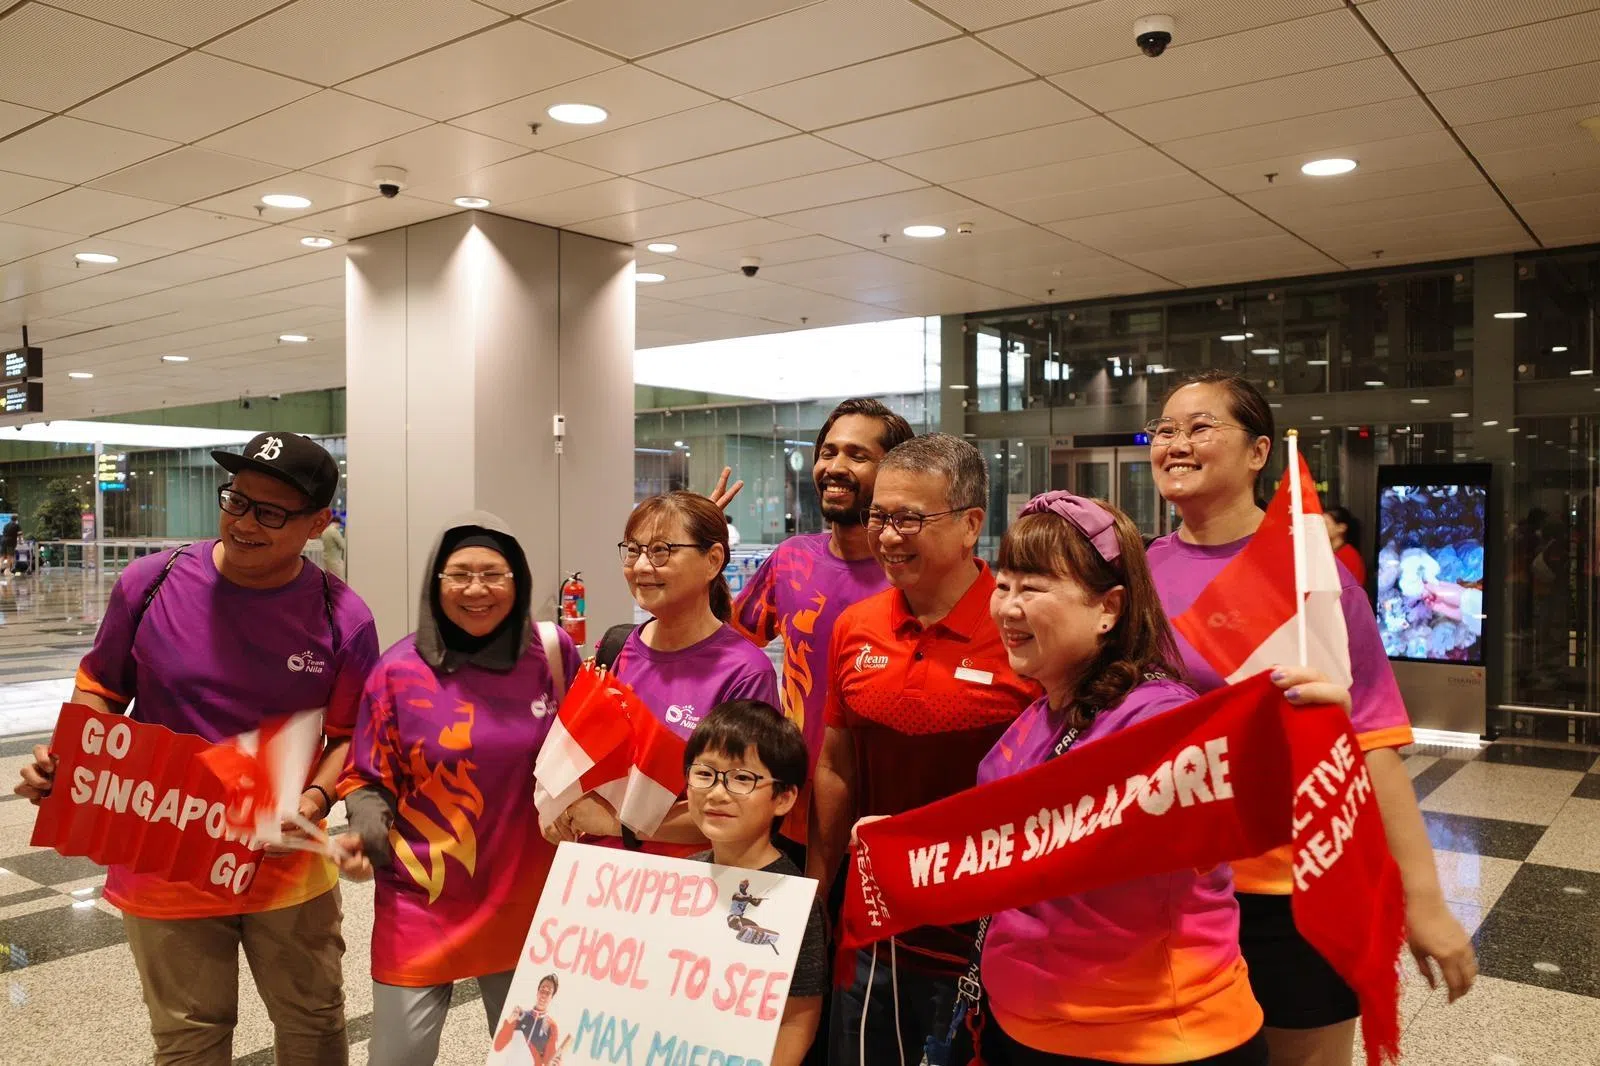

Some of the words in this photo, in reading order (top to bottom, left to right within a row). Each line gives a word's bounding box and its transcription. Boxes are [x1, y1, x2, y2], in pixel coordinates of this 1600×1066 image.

[253, 436, 284, 461] B
[305, 665, 323, 674] Nila
[306, 659, 325, 667] Team
[81, 717, 132, 760] GO
[679, 719, 697, 730] Nila
[70, 765, 262, 852] SINGAPO
[908, 841, 946, 889] WE
[953, 824, 1014, 880] ARE
[1022, 735, 1235, 861] SINGAPORE
[1292, 733, 1355, 839] CTIVE
[1292, 765, 1371, 891] HEALTH
[210, 852, 256, 895] GO
[560, 860, 579, 905] I
[586, 862, 720, 917] SKIPPED
[528, 918, 650, 990] SCHOOL
[668, 948, 711, 1001] TO
[712, 962, 789, 1021] SEE
[573, 1008, 641, 1066] MAX
